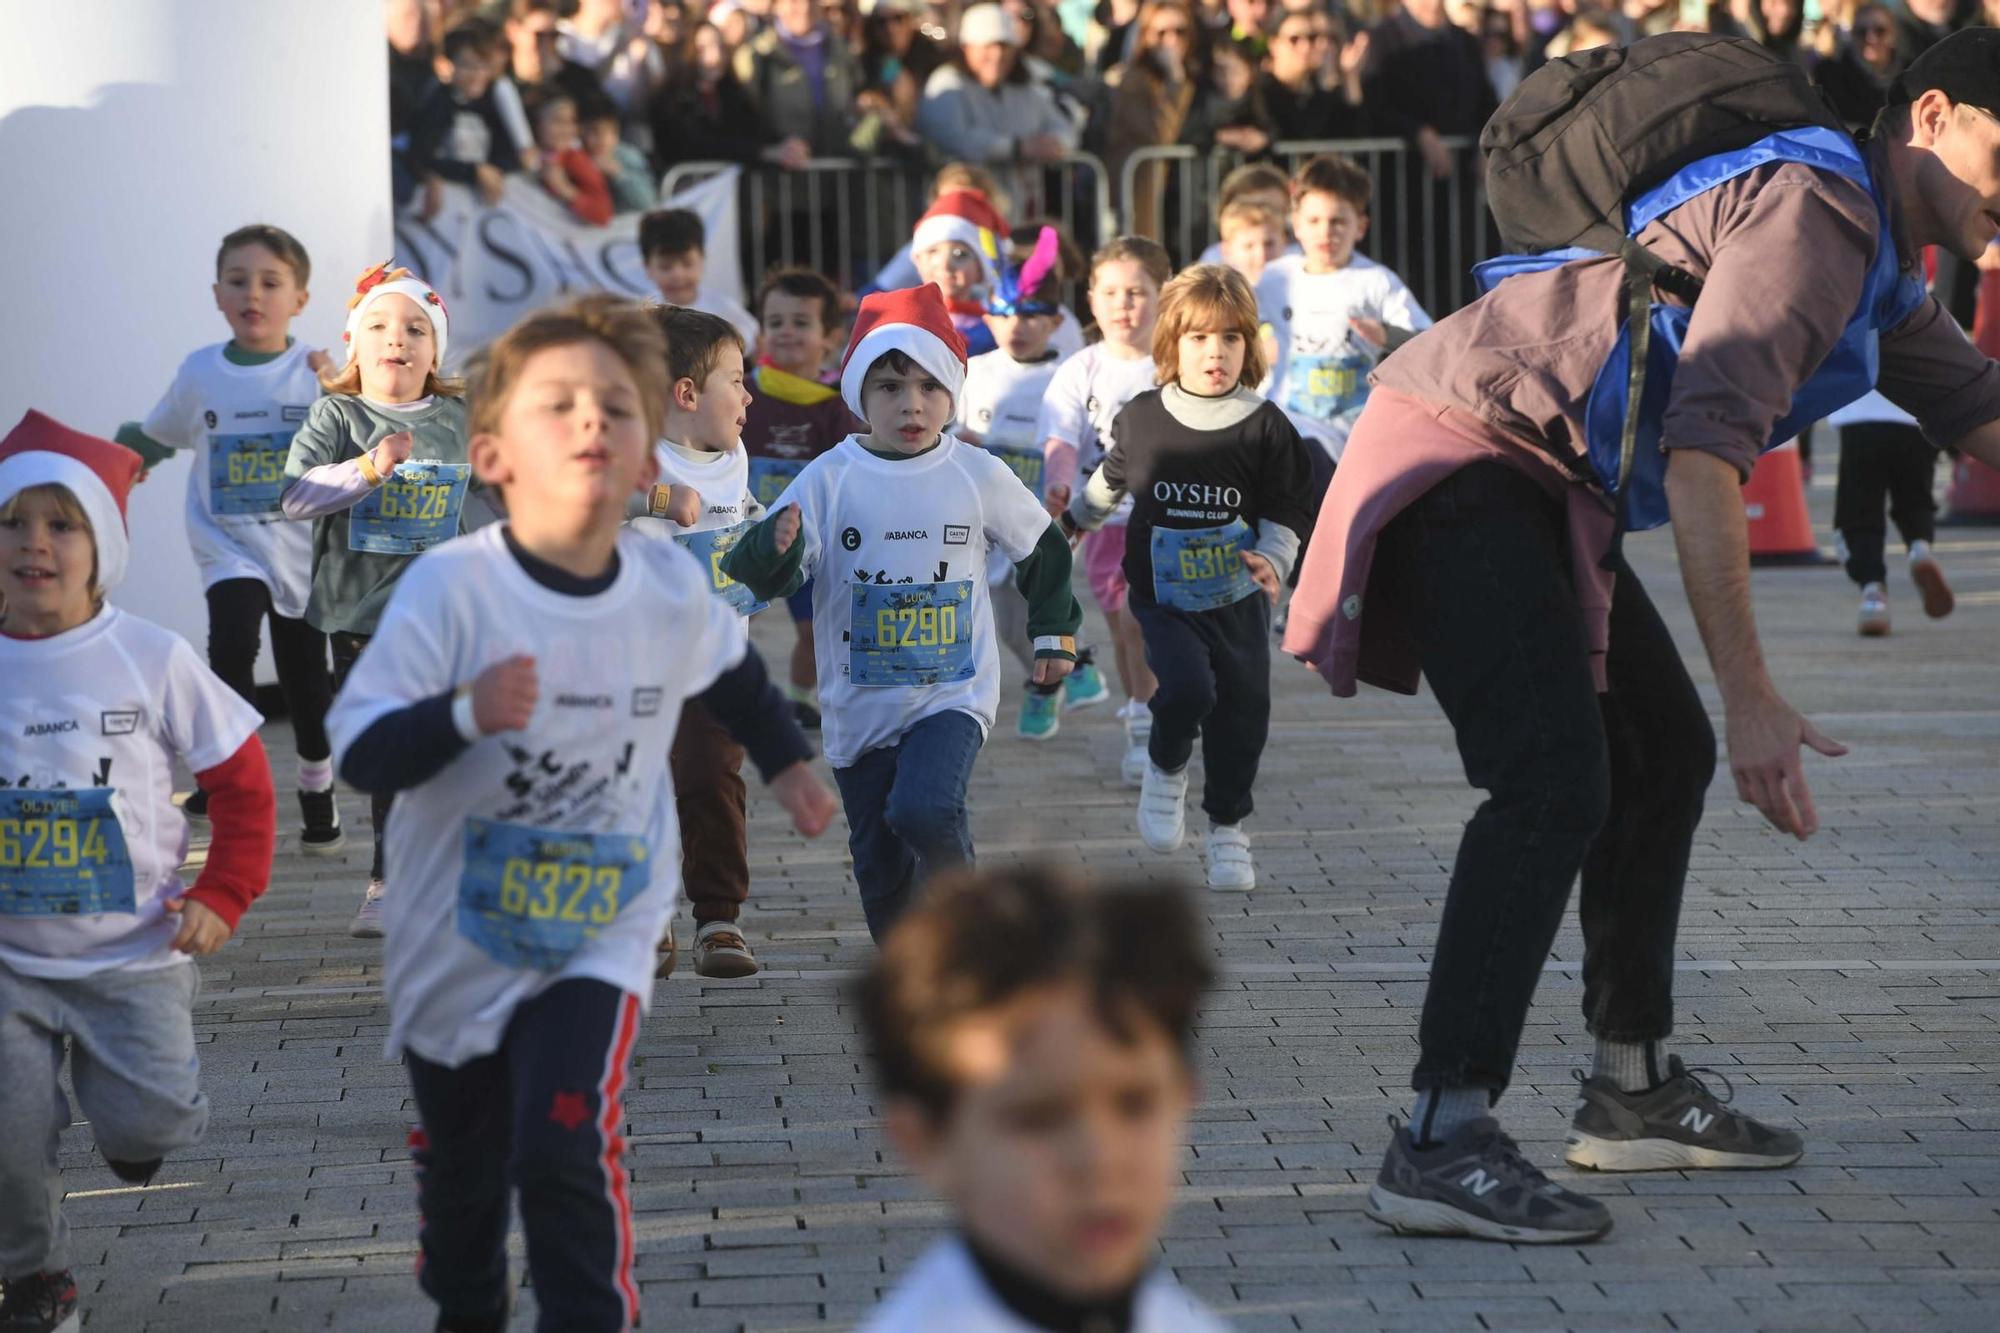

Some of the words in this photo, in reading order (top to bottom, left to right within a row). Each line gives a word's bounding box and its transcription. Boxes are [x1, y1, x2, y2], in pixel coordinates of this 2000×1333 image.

[381, 482, 451, 519] 6326
[1154, 481, 1241, 507] OYSHO
[1166, 508, 1204, 519] RUNNING
[1206, 511, 1229, 519] CLUB
[887, 530, 928, 540] ABANCA
[1179, 543, 1241, 580] 6315
[904, 591, 933, 603] LUCA
[877, 606, 956, 647] 6290
[27, 720, 79, 735] ABANCA
[0, 817, 107, 868] 6294
[502, 858, 622, 924] 6323
